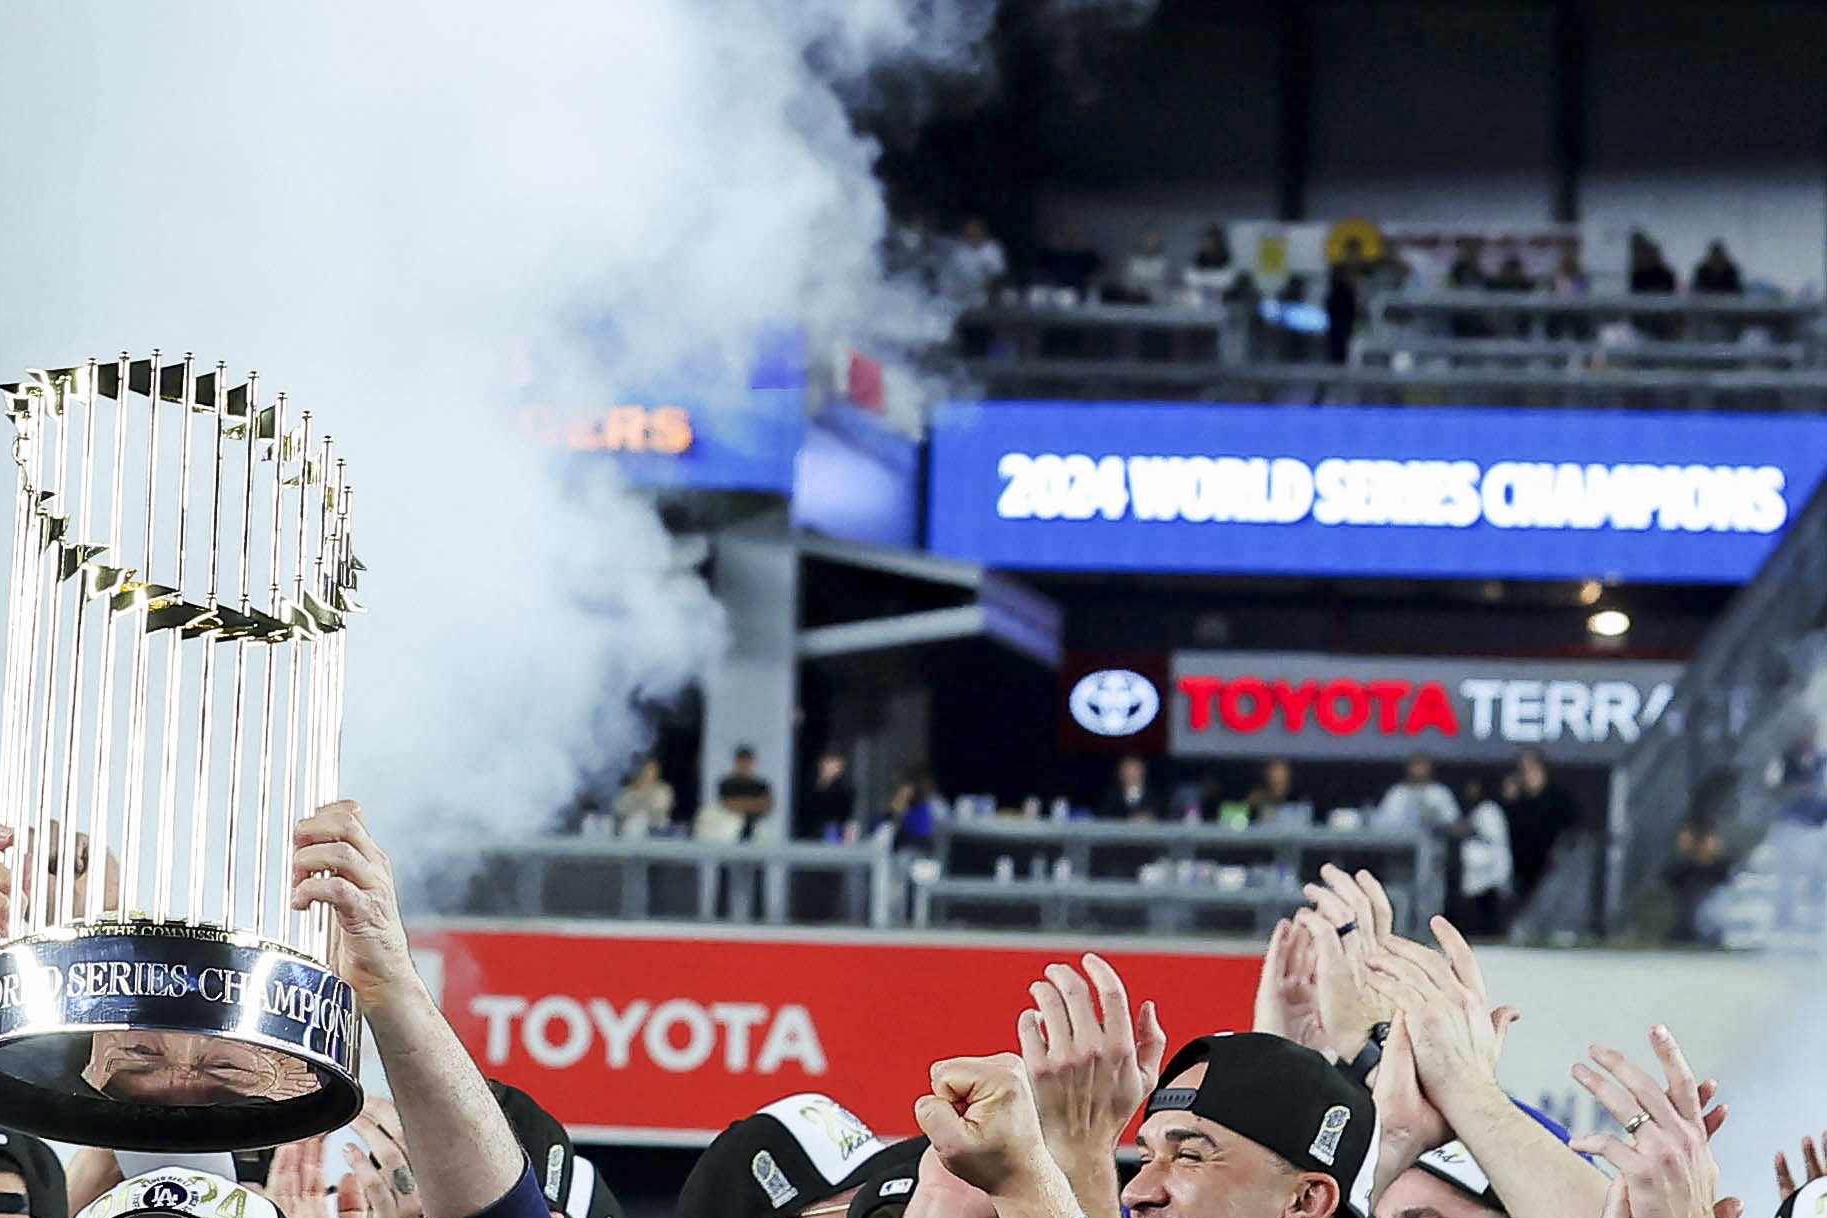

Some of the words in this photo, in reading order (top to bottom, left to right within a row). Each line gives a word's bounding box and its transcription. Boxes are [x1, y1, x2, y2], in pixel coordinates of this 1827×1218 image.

[998, 453, 1127, 520] 2024
[1129, 456, 1314, 524] WORLD
[1313, 458, 1481, 527] SERIES
[1482, 461, 1787, 534] CHAMPIONS
[1178, 675, 1459, 737] TOYOTA
[101, 926, 136, 937] THE
[140, 927, 234, 944] COMMISSIO
[66, 961, 189, 999] SERIES
[198, 967, 354, 1043] CHAMPION
[469, 994, 828, 1076] TOYOTA
[151, 1184, 179, 1207] LA
